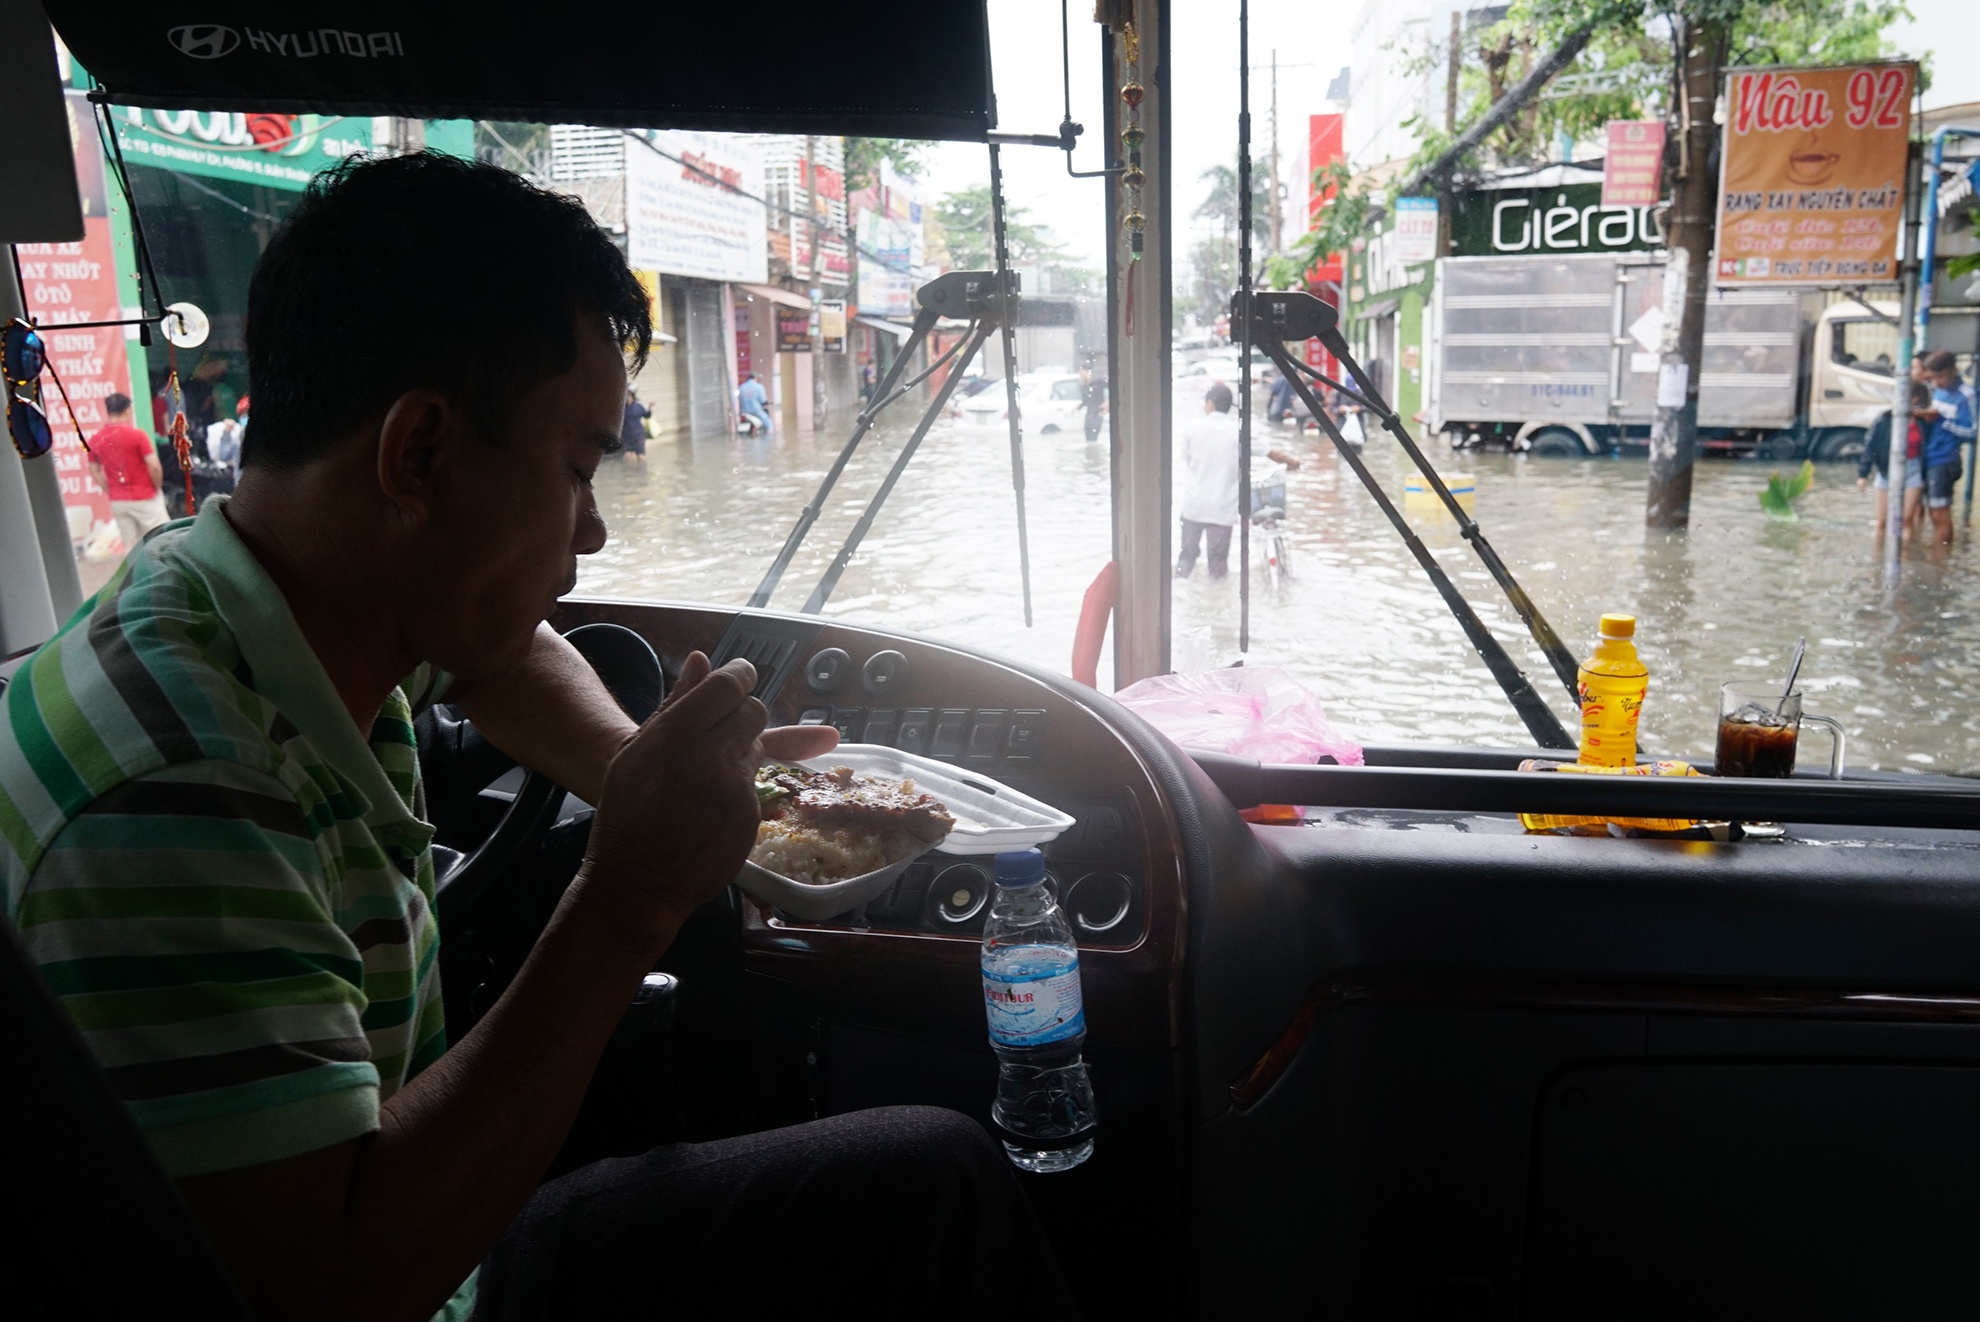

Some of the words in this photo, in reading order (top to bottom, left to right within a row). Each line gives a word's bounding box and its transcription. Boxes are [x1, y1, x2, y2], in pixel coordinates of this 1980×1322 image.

[245, 26, 405, 58] HYUNDAI
[1735, 72, 1834, 134] Nâu
[1846, 67, 1907, 129] 92
[20, 262, 48, 279] AY
